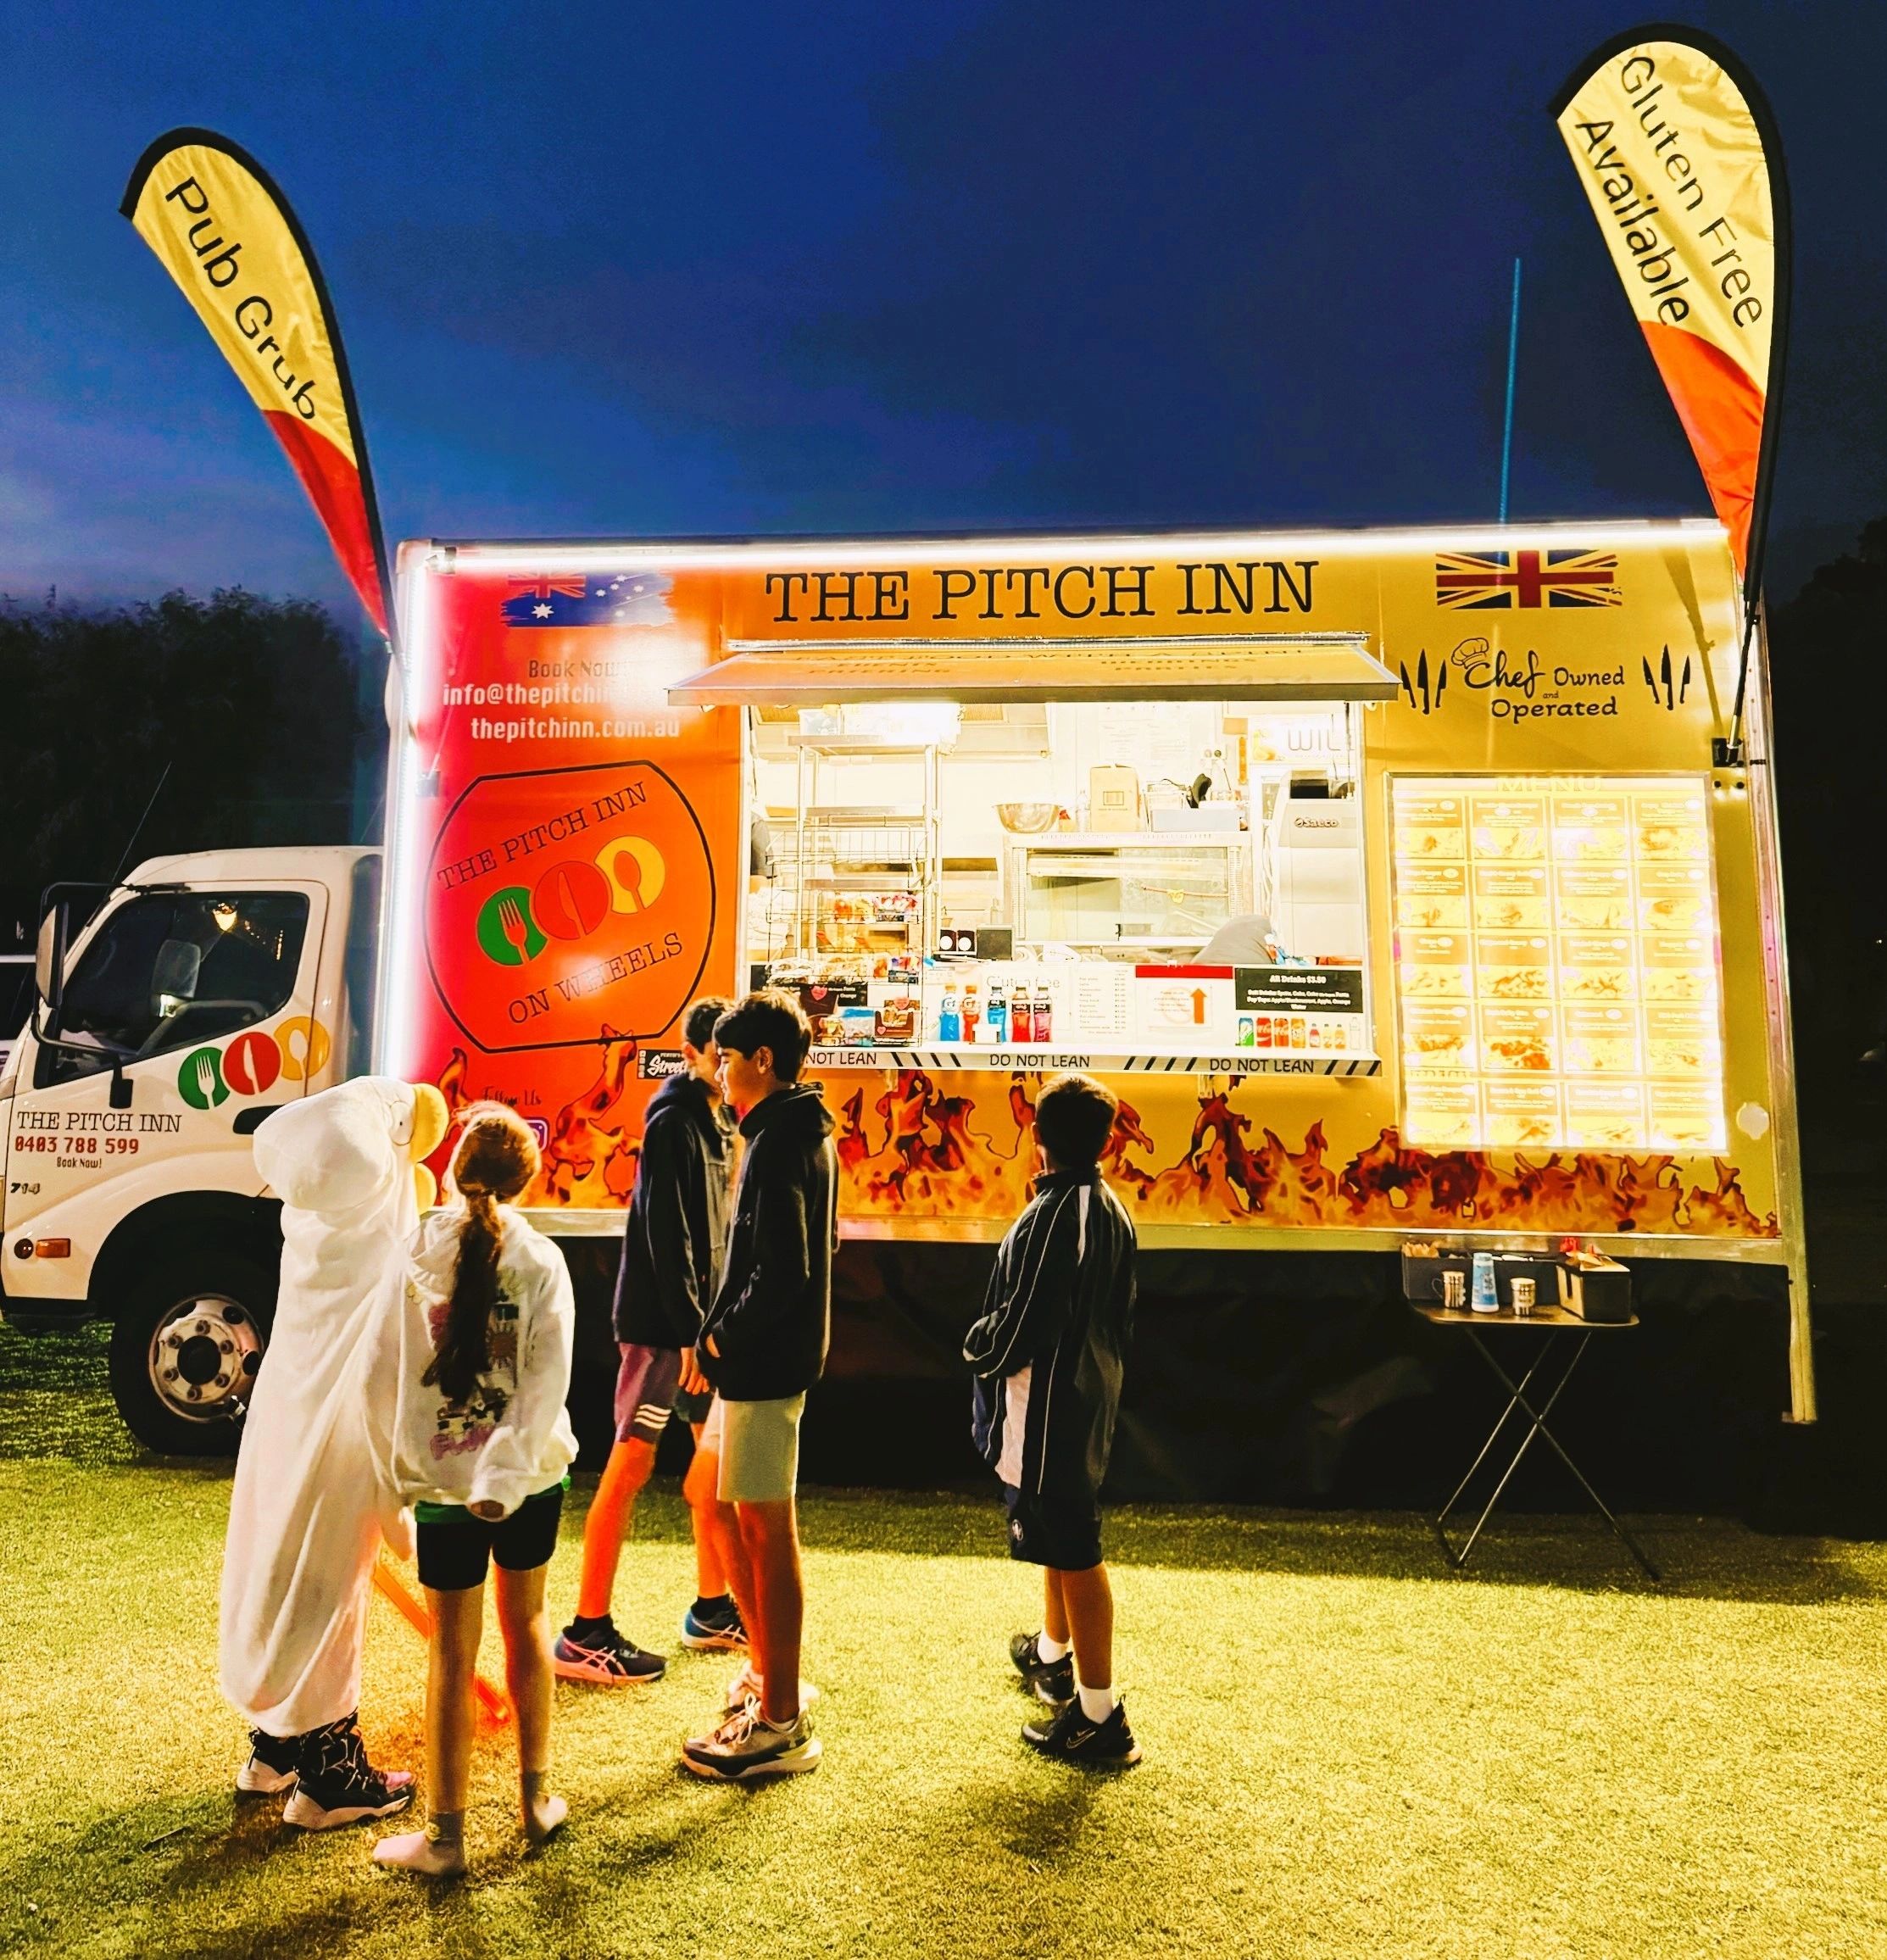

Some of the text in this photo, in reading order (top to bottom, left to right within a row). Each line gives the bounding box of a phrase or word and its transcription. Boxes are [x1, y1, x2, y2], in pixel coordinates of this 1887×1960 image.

[1621, 56, 1762, 327] Gluten Free
[1575, 120, 1689, 326] Available
[165, 176, 317, 420] Pub Grub
[765, 560, 1320, 623] THE PITCH INN
[529, 660, 576, 677] Book
[1465, 650, 1625, 699] Chef Owned
[1543, 690, 1559, 699] and
[1491, 696, 1618, 725] Operated
[470, 717, 680, 743] thepitchinn.com.au
[437, 782, 648, 891] THE PITCH INN
[509, 932, 683, 1024] ON WHEELS
[806, 1052, 877, 1065] NOT LEAN
[990, 1054, 1089, 1068] DO NOT LEAN
[1210, 1058, 1314, 1073] DO NOT LEAN
[17, 1111, 182, 1133] THE PITCH INN
[15, 1135, 139, 1154] 0403 788 599
[57, 1156, 77, 1167] Book
